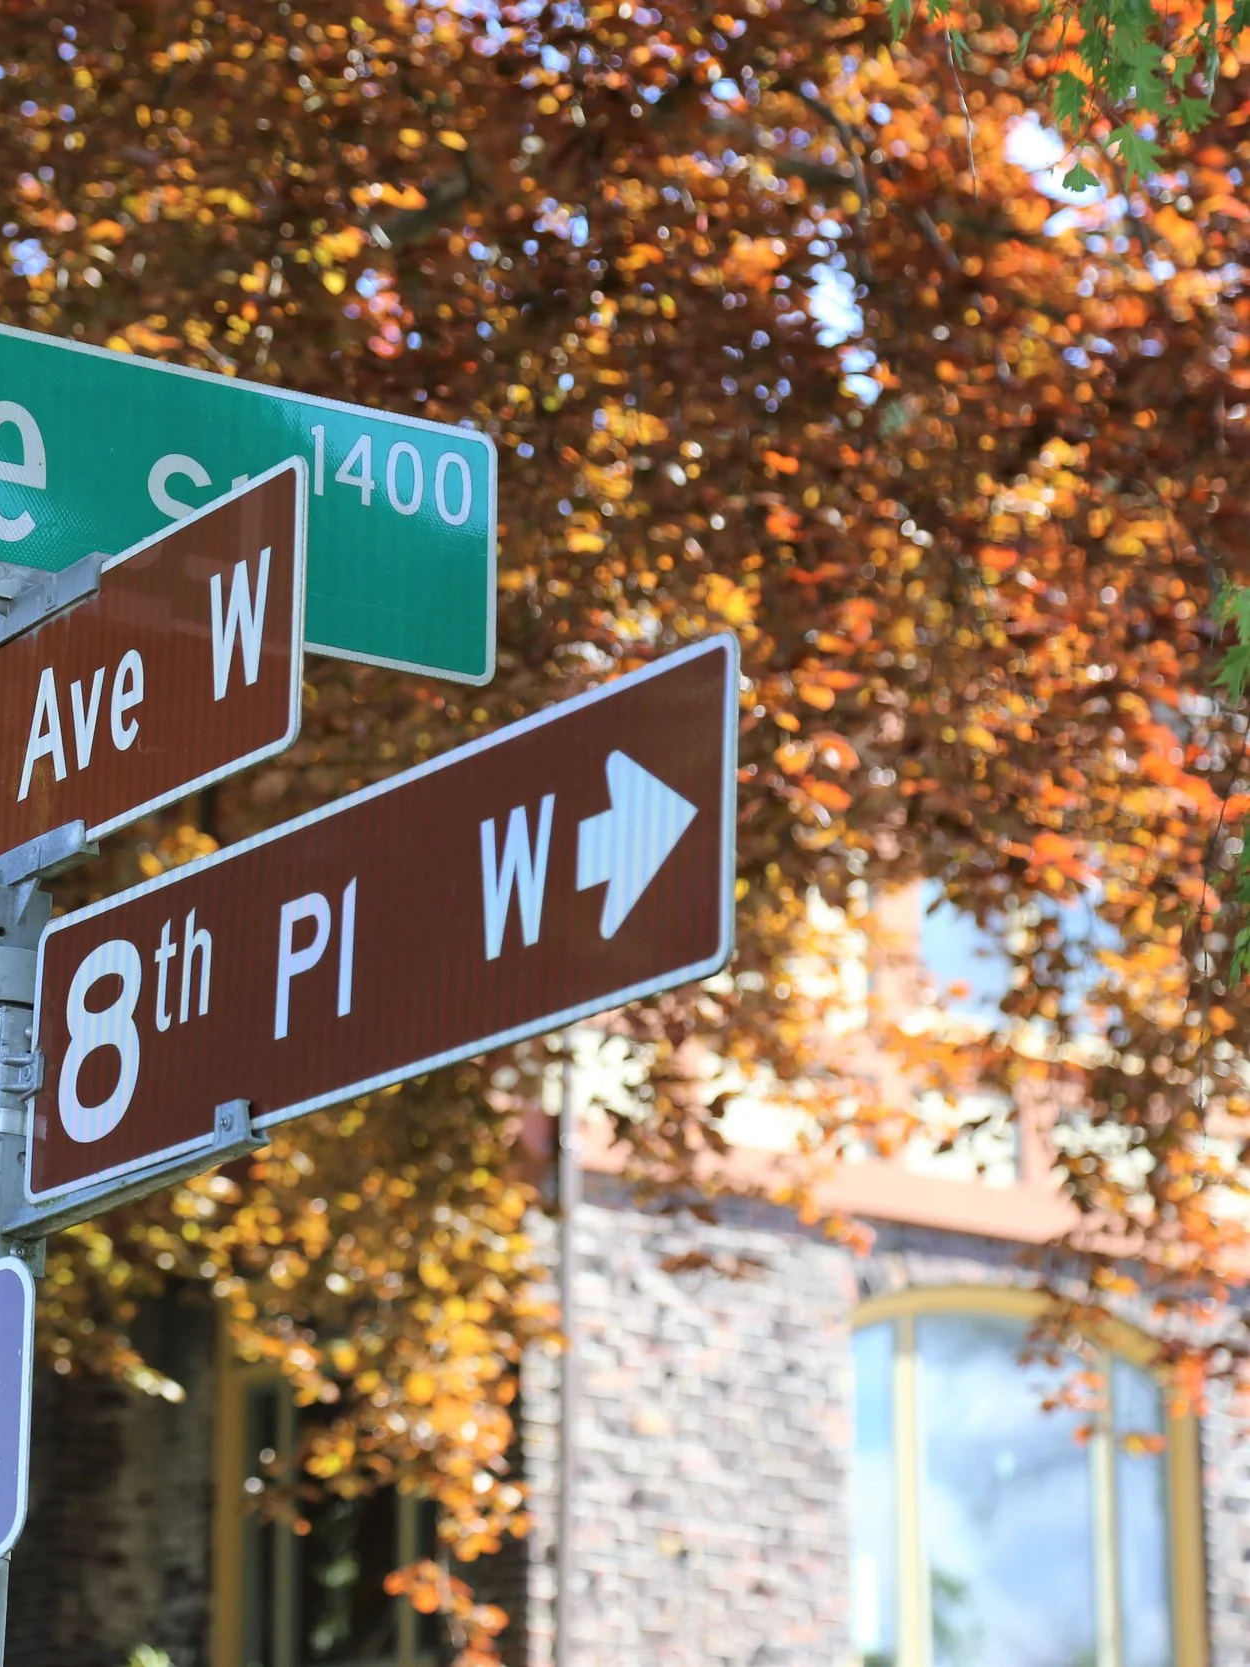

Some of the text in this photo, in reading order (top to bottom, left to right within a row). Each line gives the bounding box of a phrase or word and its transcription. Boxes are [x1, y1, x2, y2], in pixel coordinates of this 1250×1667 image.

[147, 453, 249, 532] S
[310, 424, 472, 526] 1400
[17, 649, 144, 802] Ave
[210, 546, 271, 701] W
[58, 793, 556, 1144] 8th Pl W
